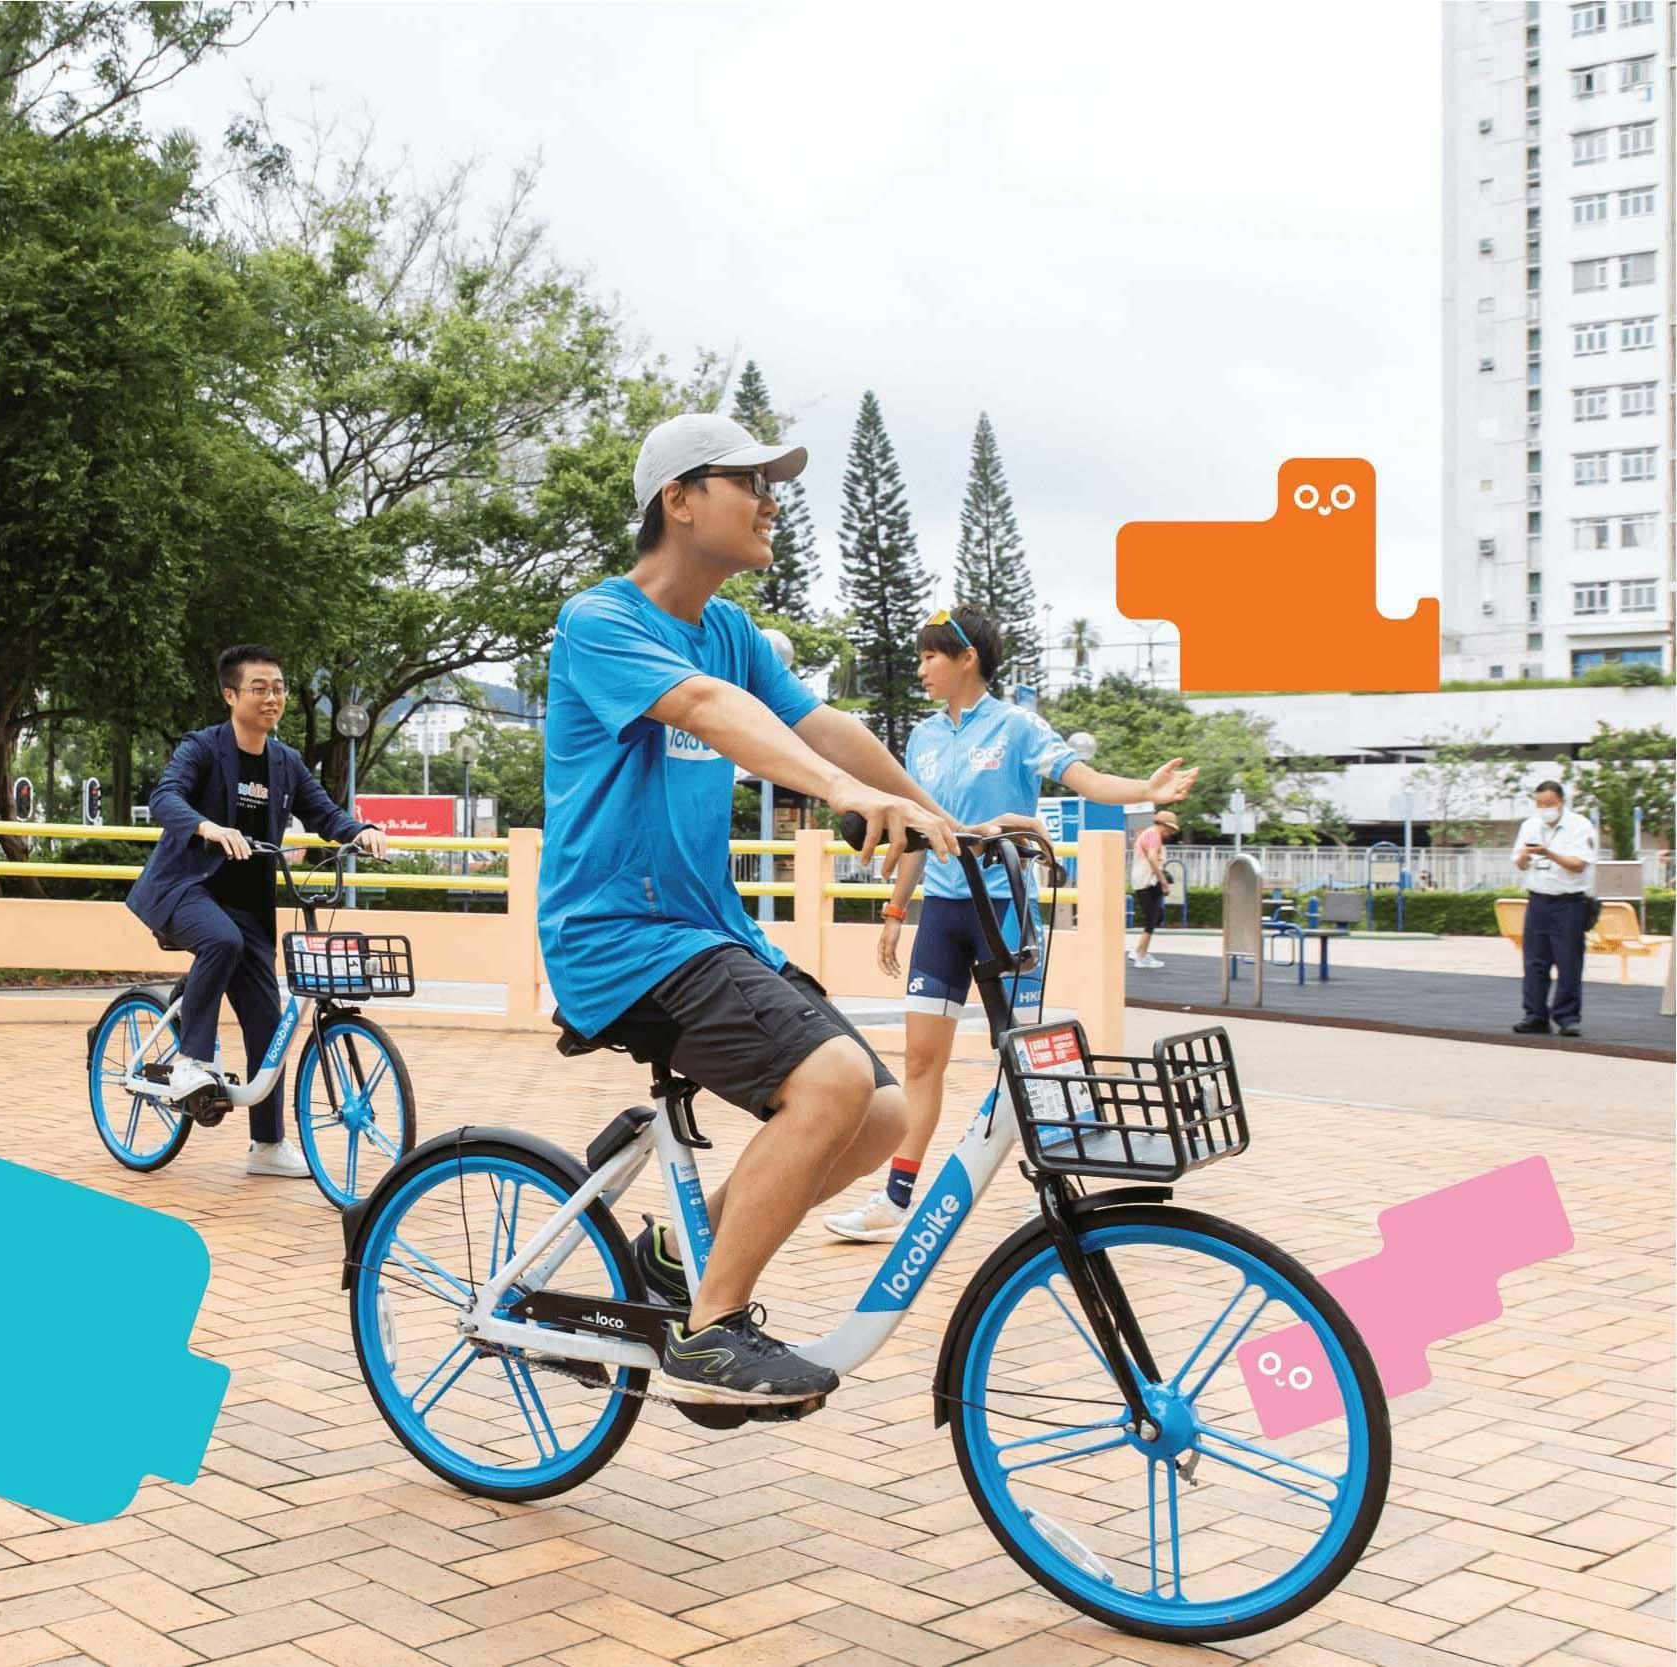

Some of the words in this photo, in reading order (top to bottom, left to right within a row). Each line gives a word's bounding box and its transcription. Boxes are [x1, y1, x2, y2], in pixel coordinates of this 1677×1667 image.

[670, 728, 710, 751] loco
[267, 1012, 294, 1063] locobike
[881, 1194, 960, 1299] locobike
